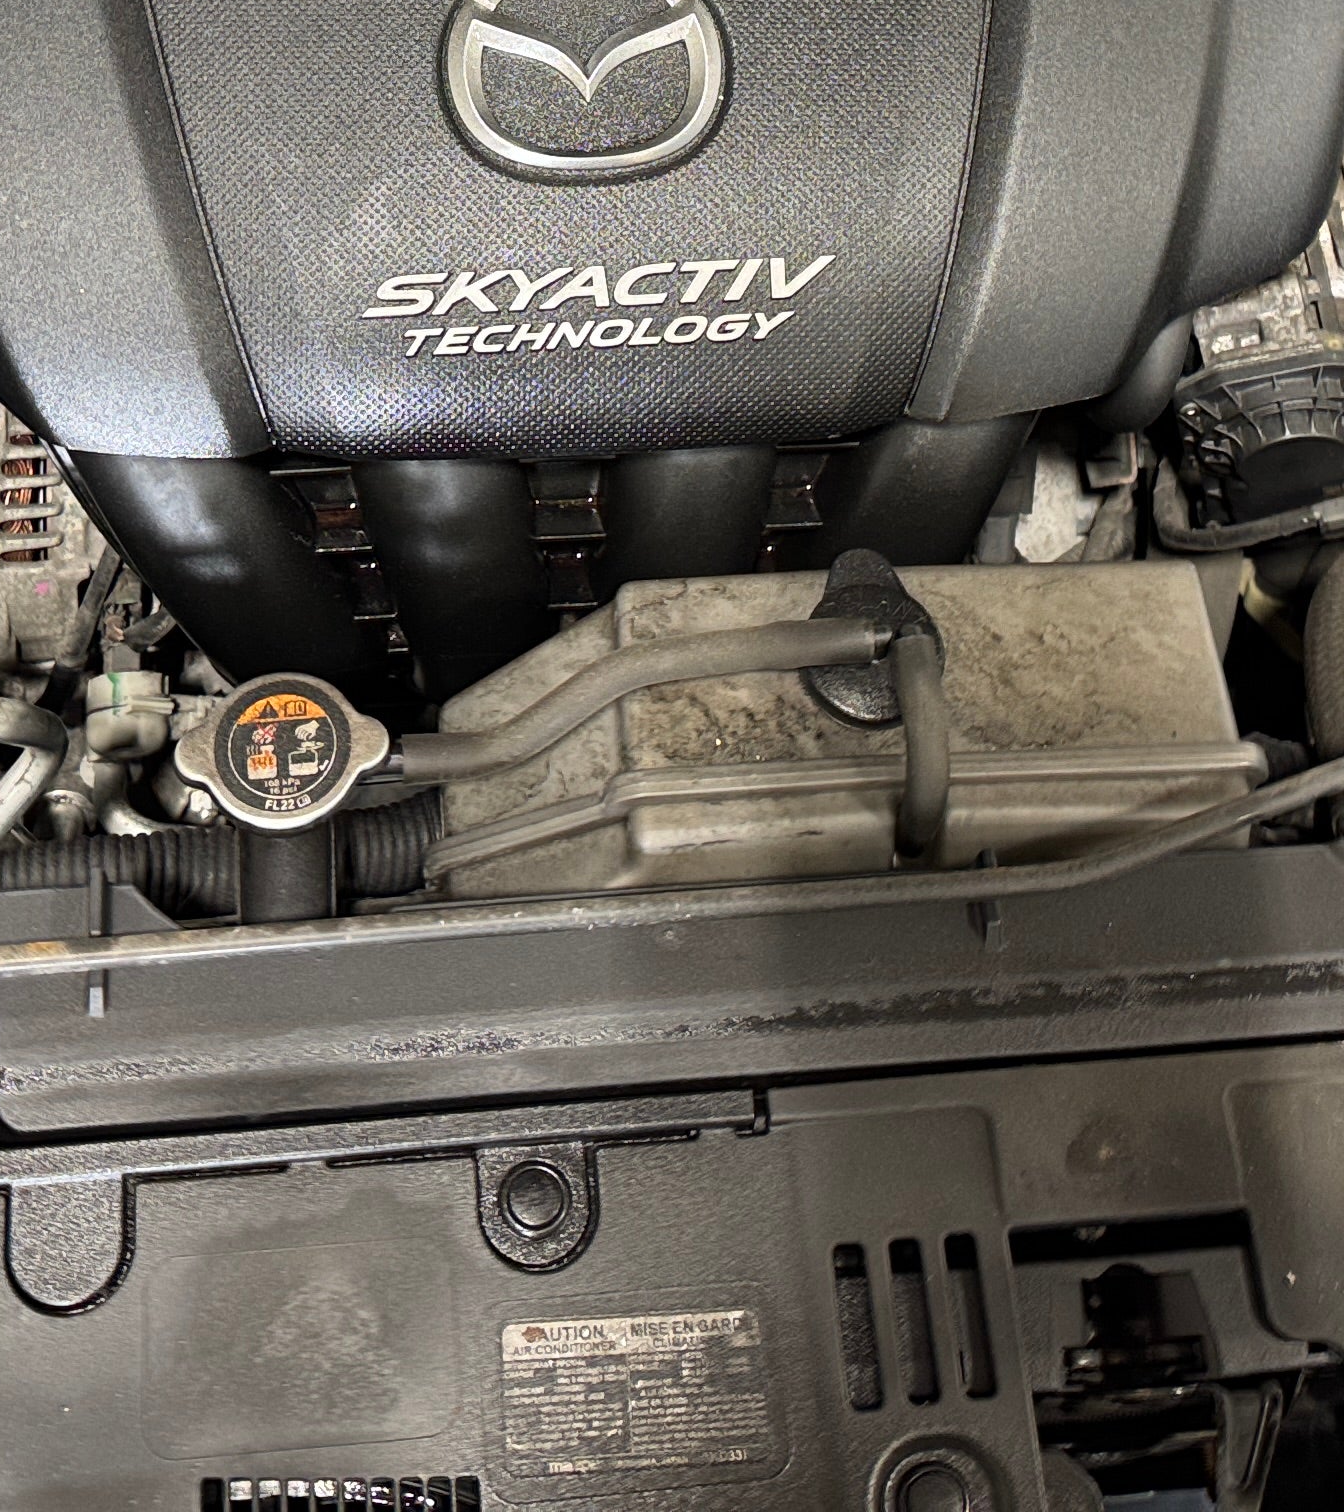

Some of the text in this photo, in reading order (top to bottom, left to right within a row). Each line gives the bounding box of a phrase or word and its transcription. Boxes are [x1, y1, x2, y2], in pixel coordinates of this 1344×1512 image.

[362, 254, 837, 319] SKYACTIV
[403, 310, 796, 358] TECHNOLOGY
[264, 798, 296, 811] FL22
[523, 1324, 608, 1344] AUTION
[630, 1321, 669, 1337] MISE
[672, 1319, 694, 1335] EN
[513, 1340, 617, 1356] AIR CONDITIONER
